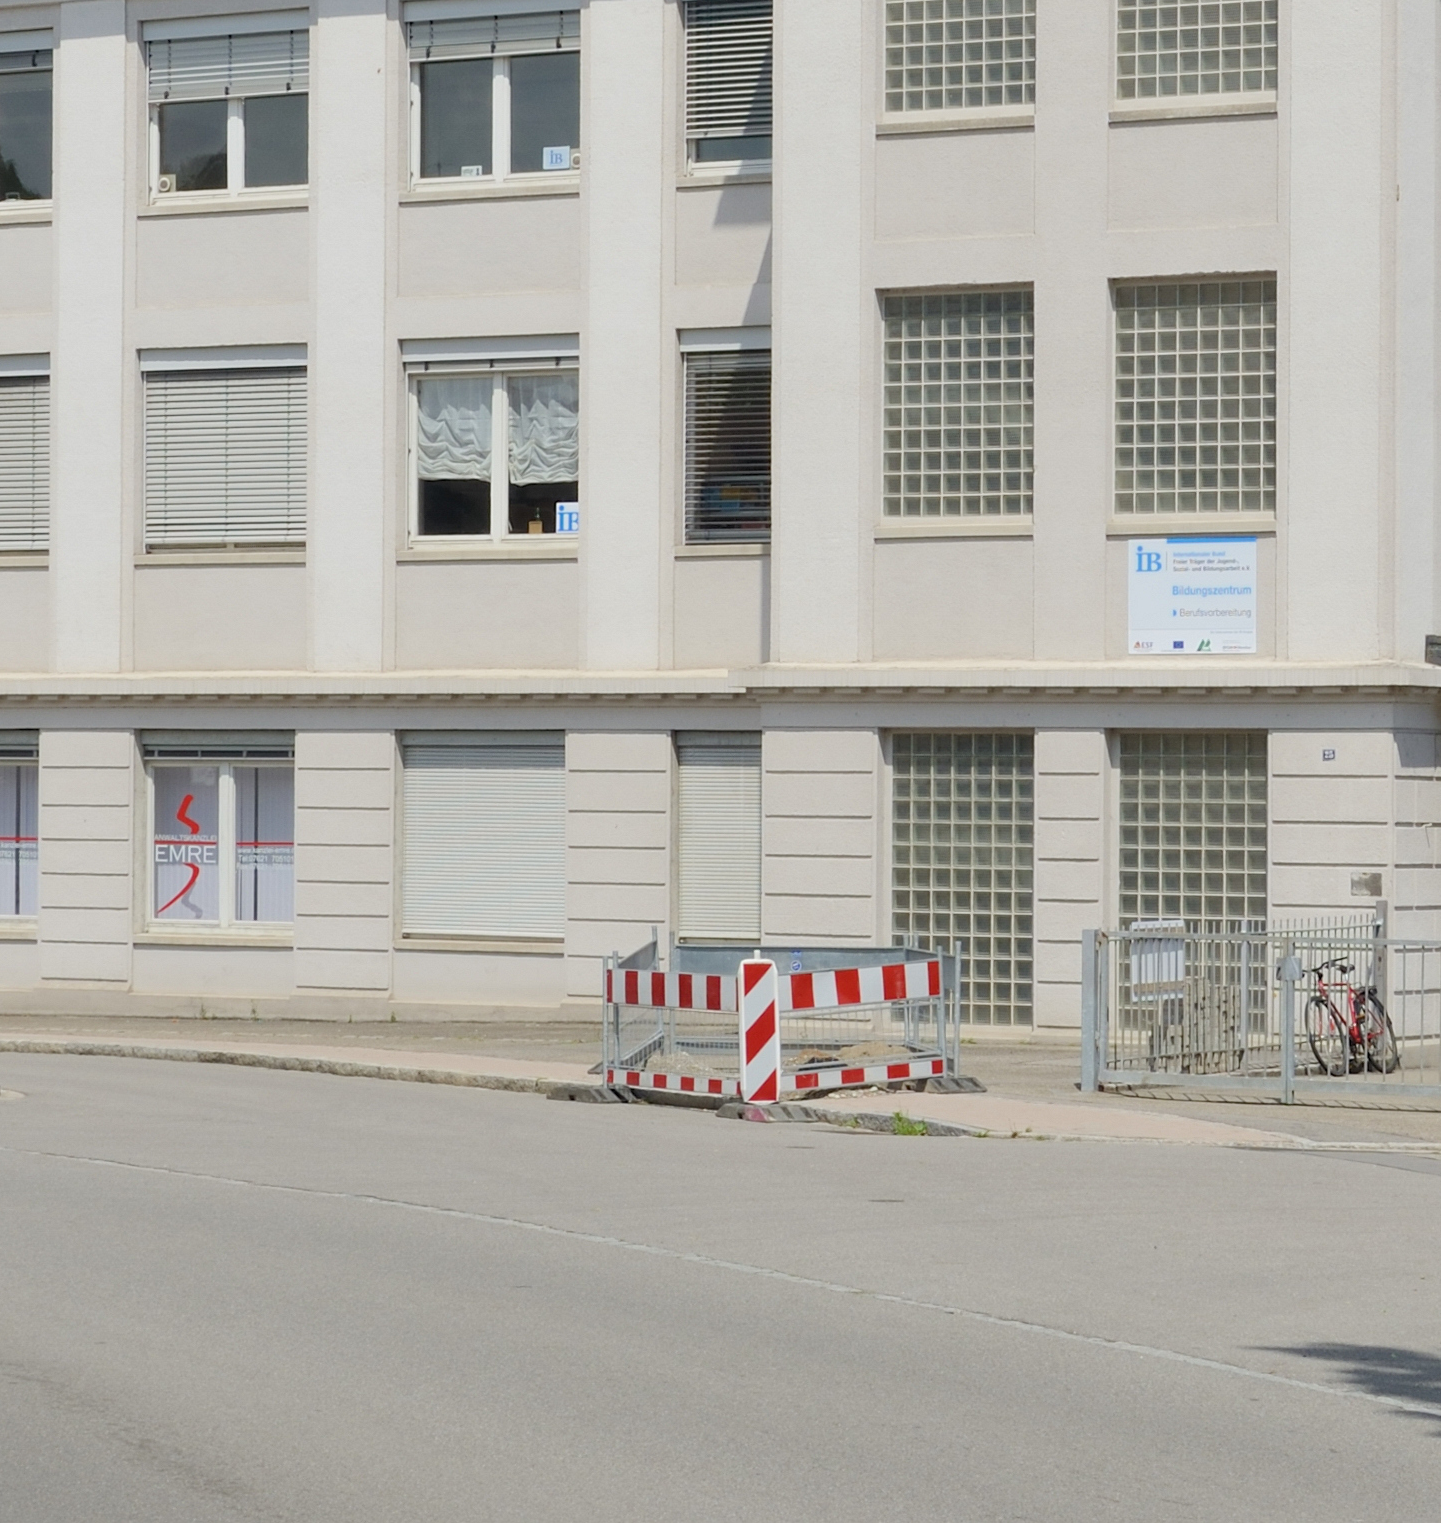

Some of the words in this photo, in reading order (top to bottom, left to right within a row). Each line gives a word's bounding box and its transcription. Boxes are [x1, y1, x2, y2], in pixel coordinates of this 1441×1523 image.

[1172, 585, 1251, 597] Bildungszentrum
[1179, 608, 1252, 619] Berufsvorbereitung
[155, 845, 216, 863] EMRE
